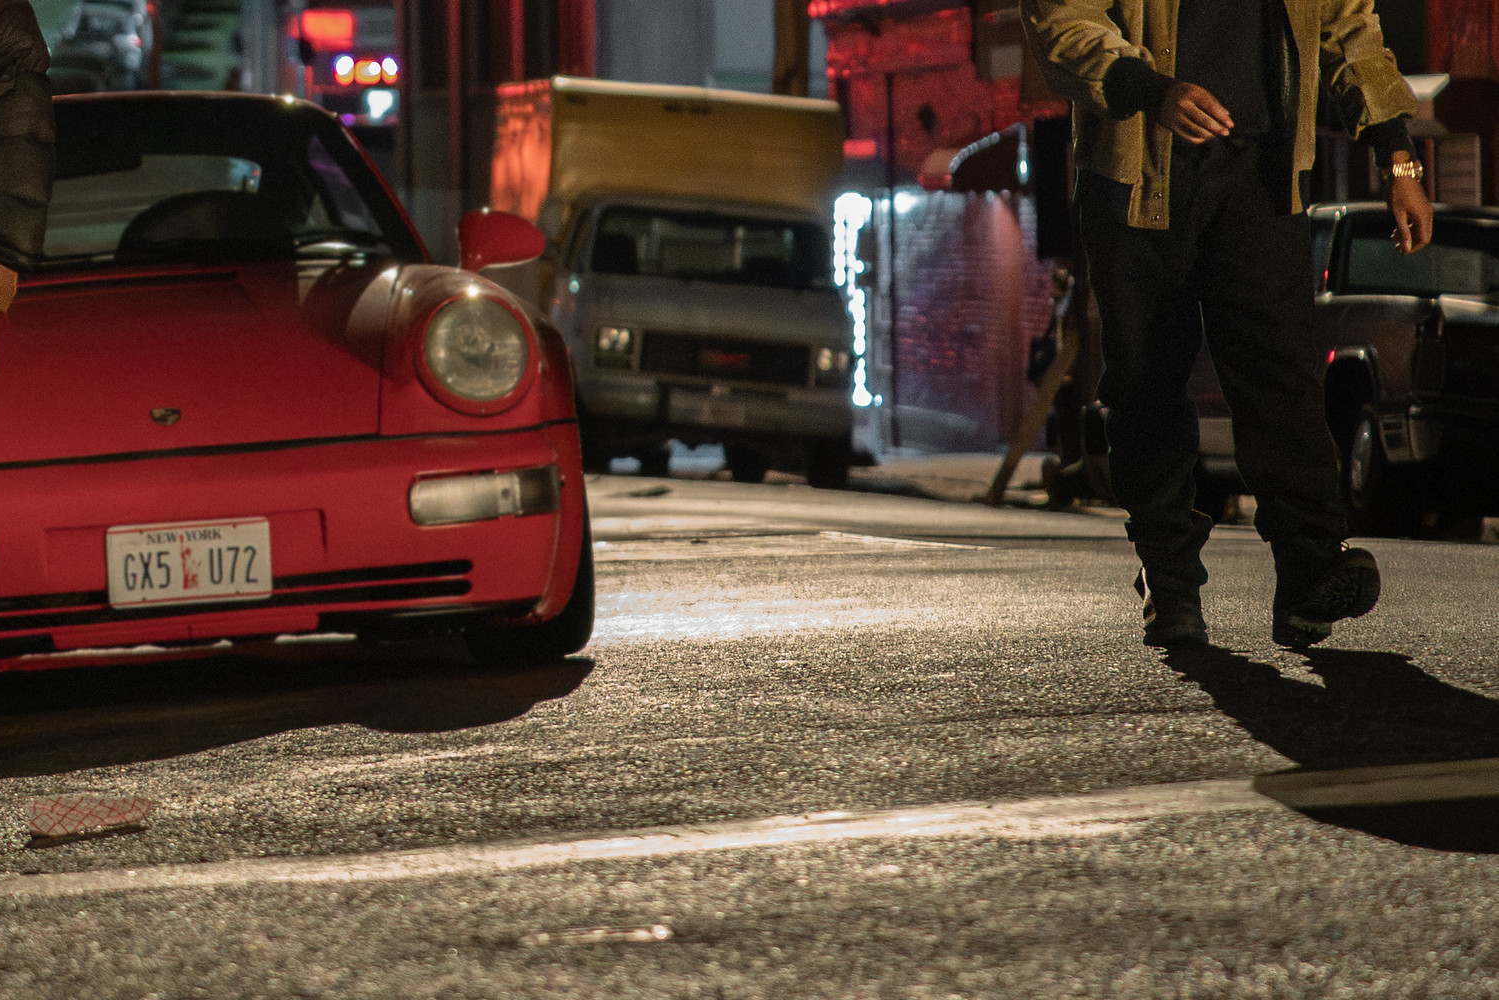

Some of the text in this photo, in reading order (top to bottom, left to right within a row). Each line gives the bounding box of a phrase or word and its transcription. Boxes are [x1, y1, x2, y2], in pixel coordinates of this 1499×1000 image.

[146, 528, 222, 545] NEW YORK
[124, 546, 258, 591] GX5 U72
